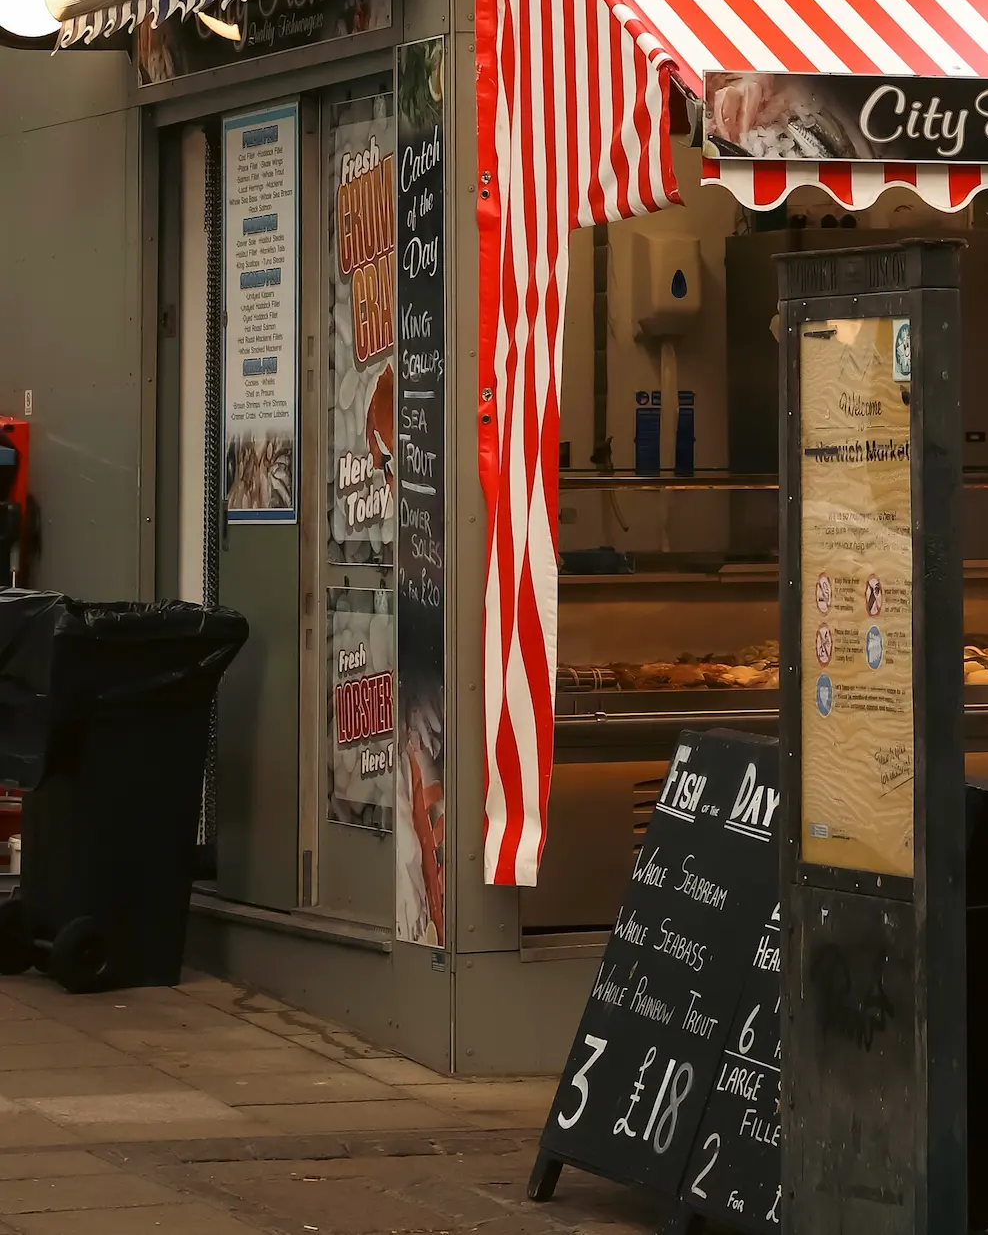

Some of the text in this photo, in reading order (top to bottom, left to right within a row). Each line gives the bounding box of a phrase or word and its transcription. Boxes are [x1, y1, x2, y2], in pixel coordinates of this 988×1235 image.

[859, 83, 969, 157] City
[341, 135, 381, 186] Fresh
[401, 125, 440, 192] Catch
[407, 188, 434, 231] of the
[403, 236, 439, 279] Day
[401, 302, 432, 340] KING
[401, 406, 428, 434] SEA
[838, 392, 883, 418] Welcome
[339, 452, 374, 490] Here
[400, 433, 437, 477] TROUT
[347, 484, 390, 526] Today
[400, 497, 432, 538] DOVER
[339, 643, 366, 673] Fresh
[361, 749, 386, 775] Here
[660, 744, 707, 814] FISH
[729, 762, 780, 828] DAY
[632, 846, 668, 888] WHOLE
[674, 854, 728, 911] SEABREAM
[614, 906, 707, 972] WHOLE SEABASS
[592, 961, 718, 1040] WHOLE RAINBOW TROUT
[738, 1004, 761, 1055] 6
[557, 1034, 693, 1154] 3 £18
[716, 1062, 765, 1101] LARGE
[691, 1132, 720, 1199] 2
[727, 1190, 745, 1213] FOR
